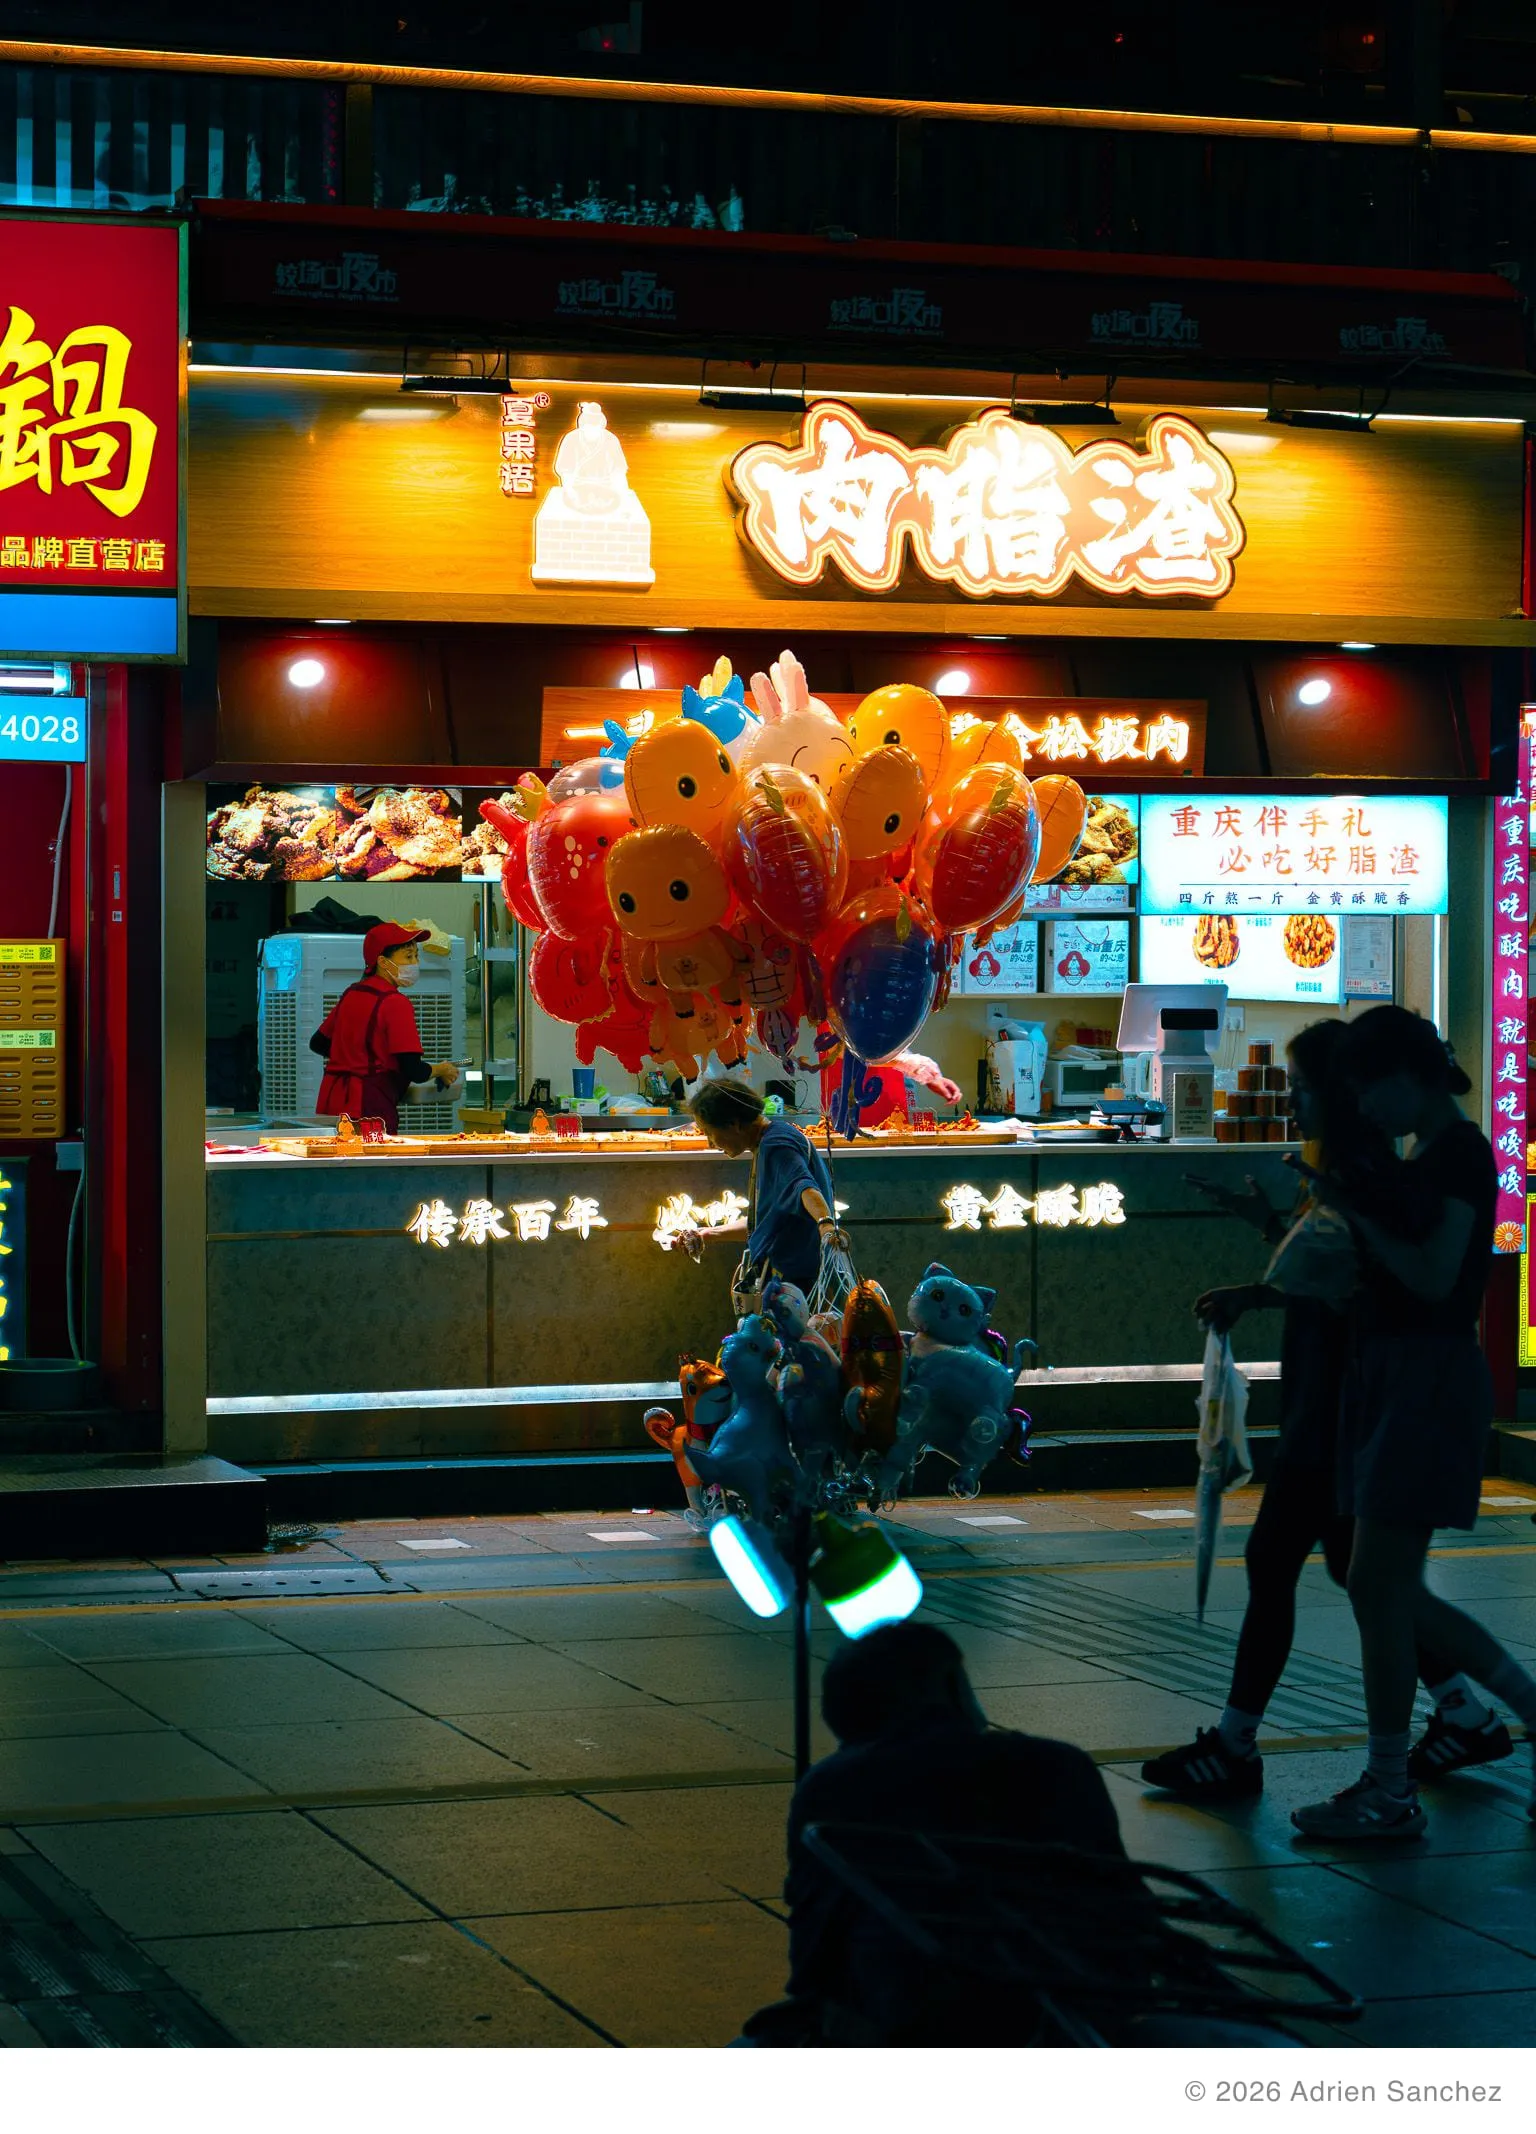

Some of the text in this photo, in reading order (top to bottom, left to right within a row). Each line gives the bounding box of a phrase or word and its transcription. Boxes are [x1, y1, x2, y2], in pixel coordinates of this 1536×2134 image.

[500, 395, 537, 495] 夏果语
[757, 417, 1223, 583] 肉脂渣
[0, 536, 166, 571] 品牌直营店
[0, 715, 79, 744] 4028
[1170, 805, 1373, 838] 重庆伴手礼
[1219, 843, 1420, 876] 必吃好脂渣
[1179, 890, 1411, 906] 四斤熬一斤 金黄酥脆香
[408, 1194, 609, 1248] 传承百年
[942, 1182, 1128, 1231] 黄金酥脆
